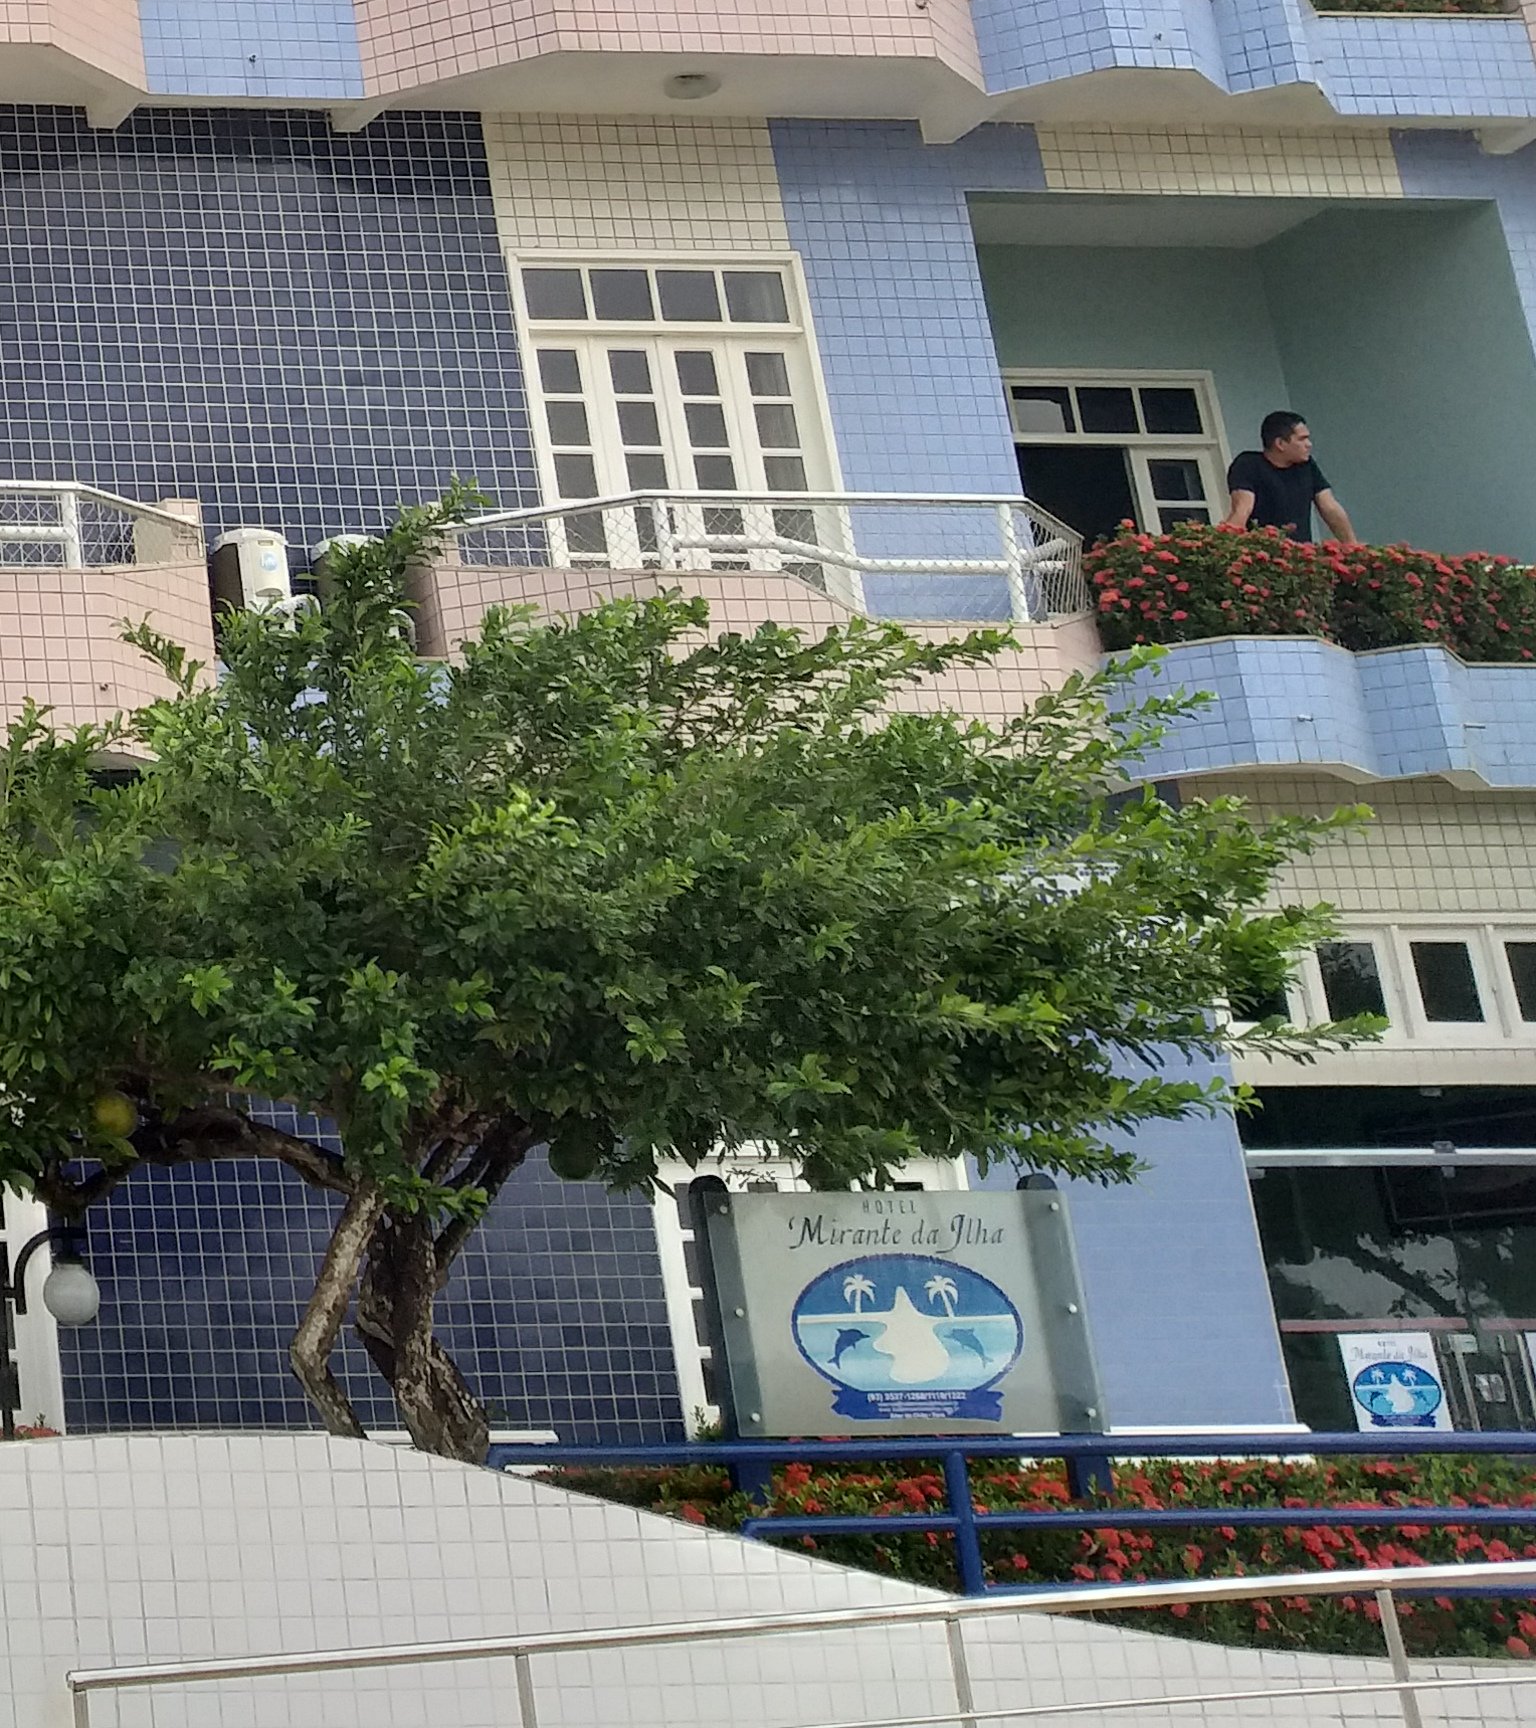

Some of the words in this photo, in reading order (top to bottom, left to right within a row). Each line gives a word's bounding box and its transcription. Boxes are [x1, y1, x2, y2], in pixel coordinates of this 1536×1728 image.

[861, 1199, 917, 1215] HOTEL
[789, 1214, 902, 1249] Mirante
[911, 1218, 940, 1246] da
[935, 1213, 1004, 1254] Ilha
